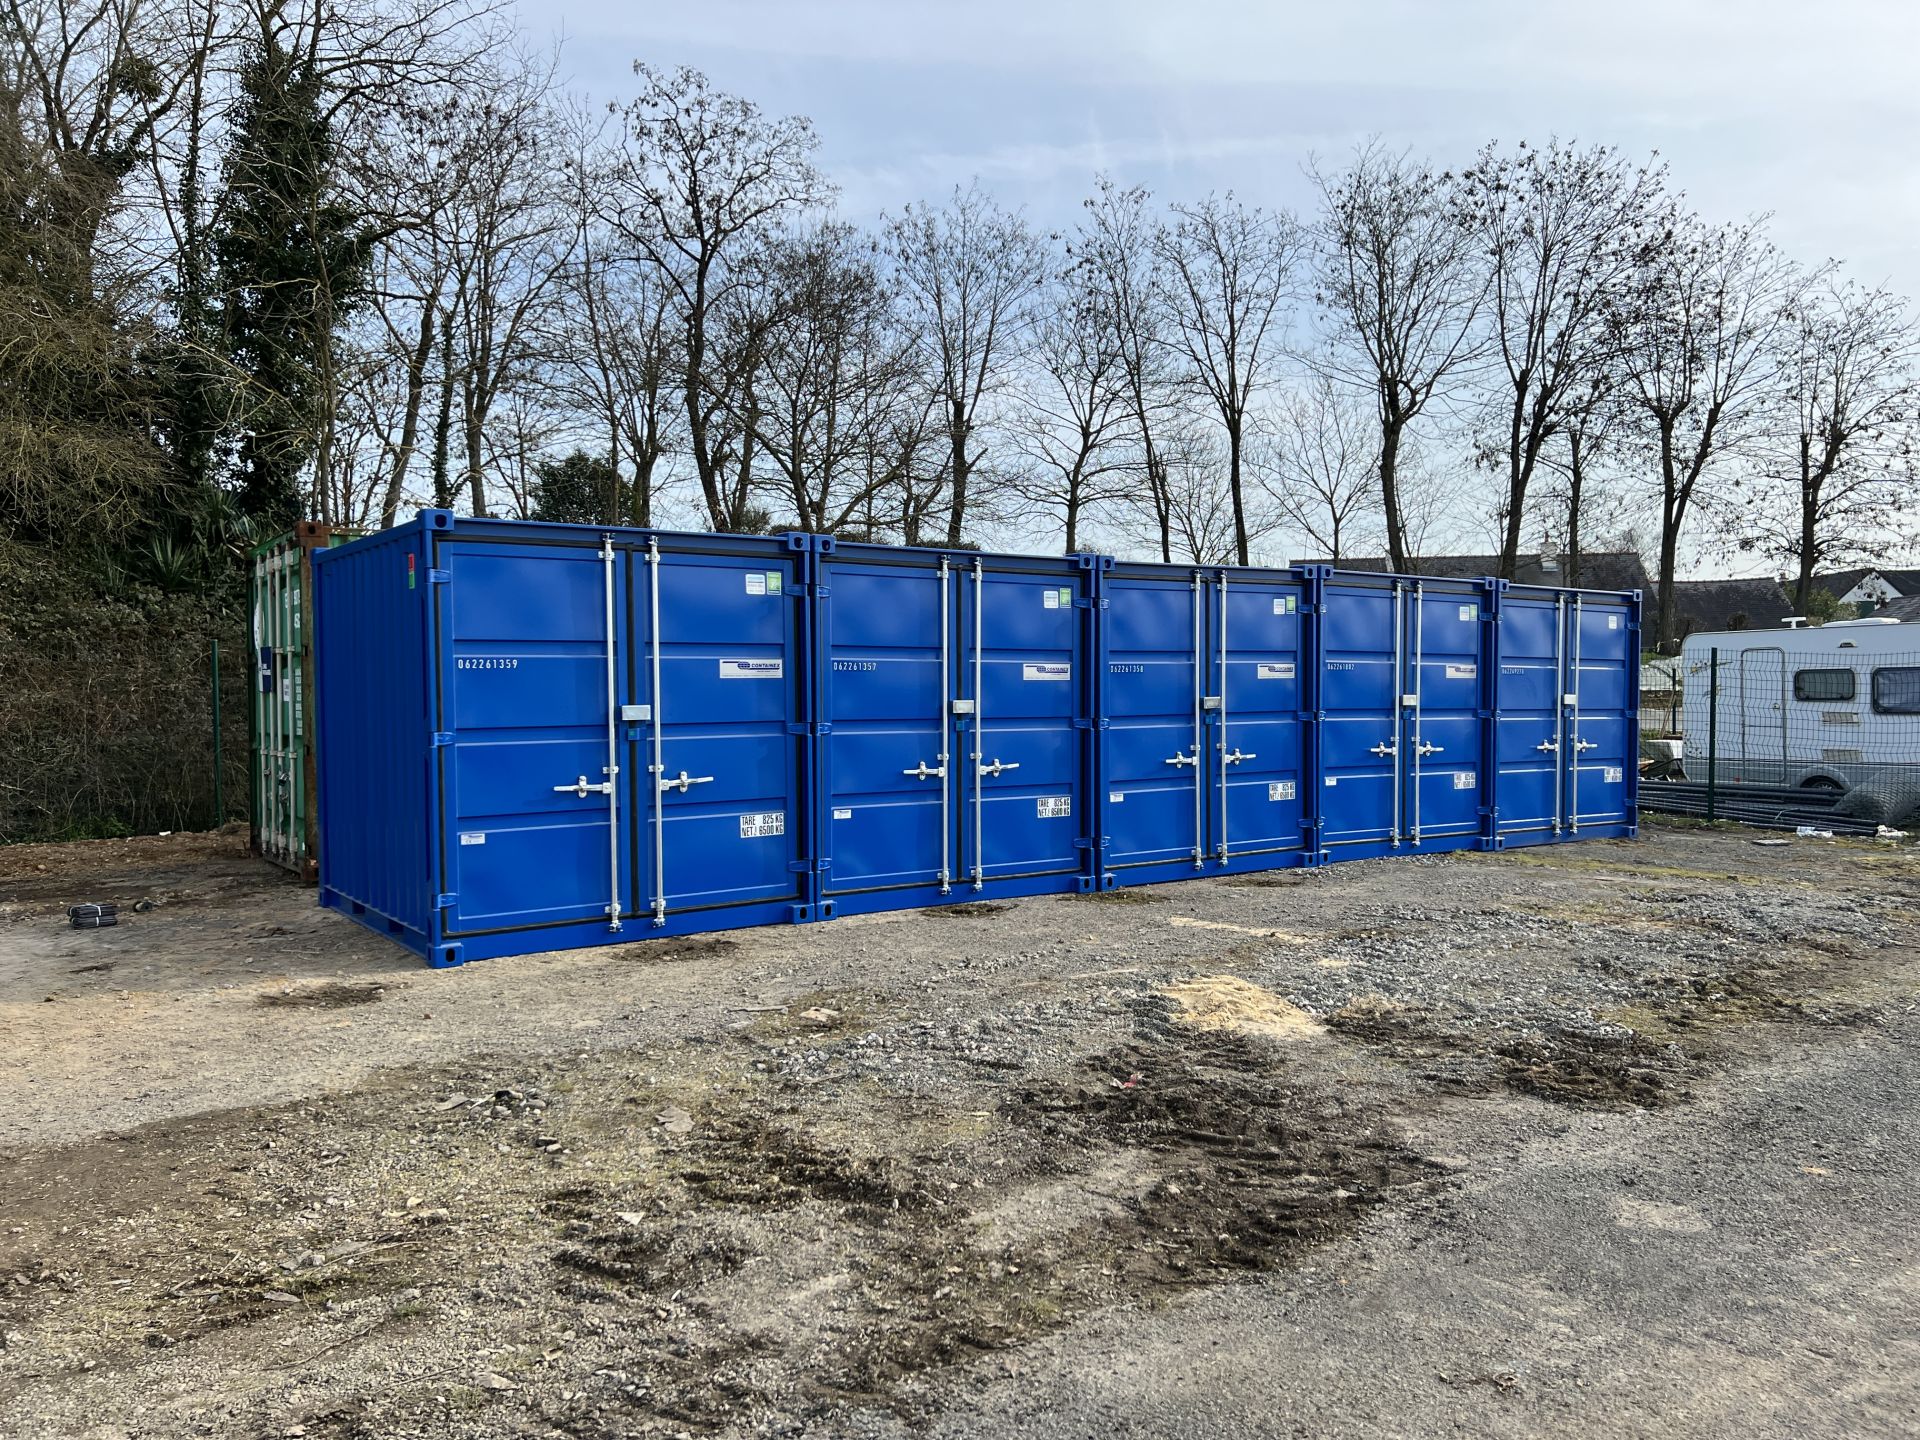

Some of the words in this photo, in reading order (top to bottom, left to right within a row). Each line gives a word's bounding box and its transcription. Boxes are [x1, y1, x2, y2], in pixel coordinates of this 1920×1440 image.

[458, 659, 517, 669] 062261359
[833, 662, 876, 671] 062261357
[742, 816, 756, 826] TARE
[763, 813, 774, 825] 825
[775, 813, 783, 824] KG
[759, 825, 774, 835] 6500
[775, 823, 783, 833] KG
